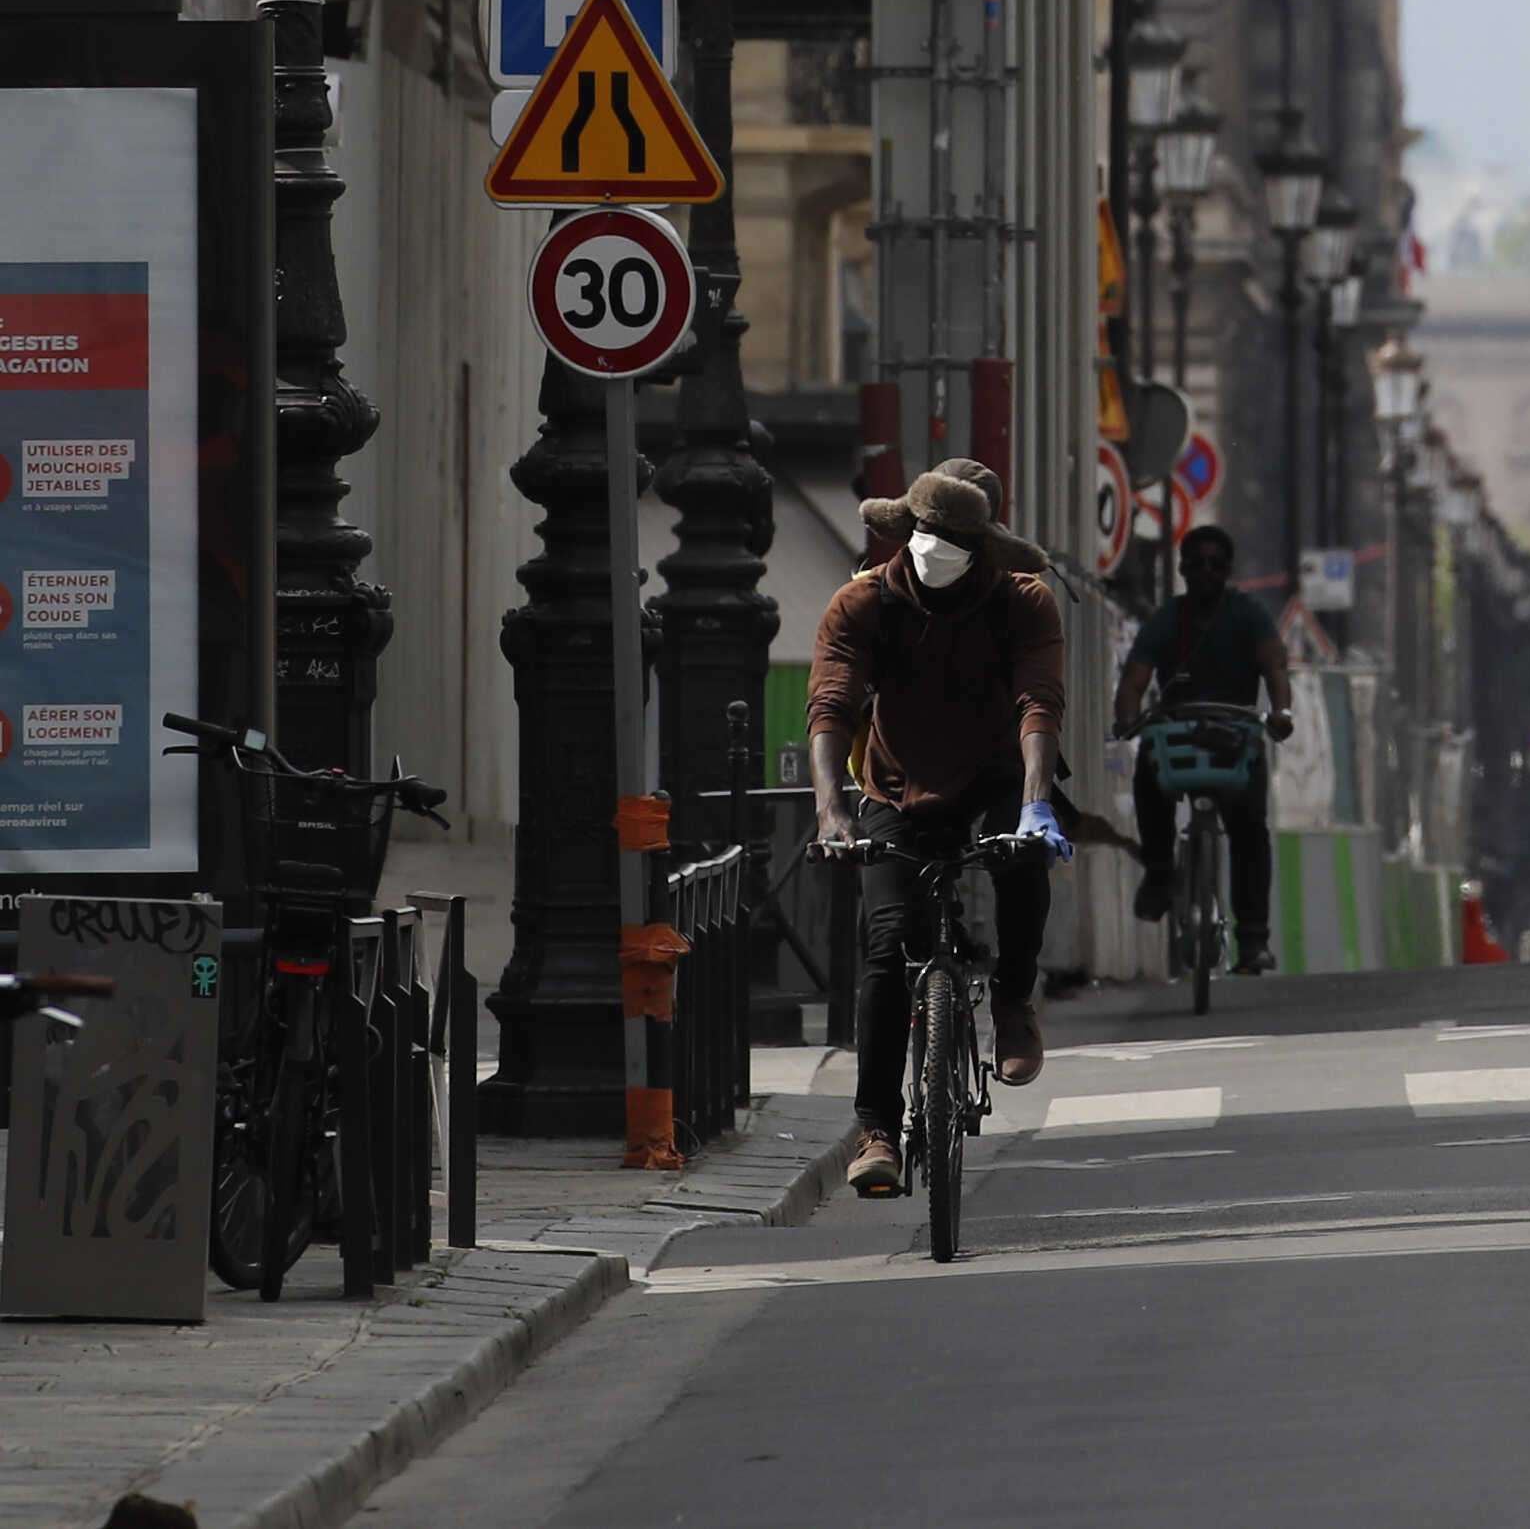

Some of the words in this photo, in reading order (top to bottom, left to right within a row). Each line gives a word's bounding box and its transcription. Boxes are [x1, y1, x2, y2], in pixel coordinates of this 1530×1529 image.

[562, 259, 659, 328] 30
[0, 335, 79, 351] GESTES
[27, 445, 94, 456] UTILISER
[99, 445, 128, 456] DES
[27, 462, 123, 474] MOUCHOIRS
[27, 480, 101, 491] JETABLES
[27, 573, 110, 587] ÉTERNUER
[27, 593, 71, 604] DANS
[75, 592, 108, 604] SON
[27, 610, 82, 622] COUDE
[27, 707, 78, 721] AÉRER
[83, 709, 117, 721] SON
[27, 727, 113, 739] LOGEMENT
[64, 803, 84, 811] sur
